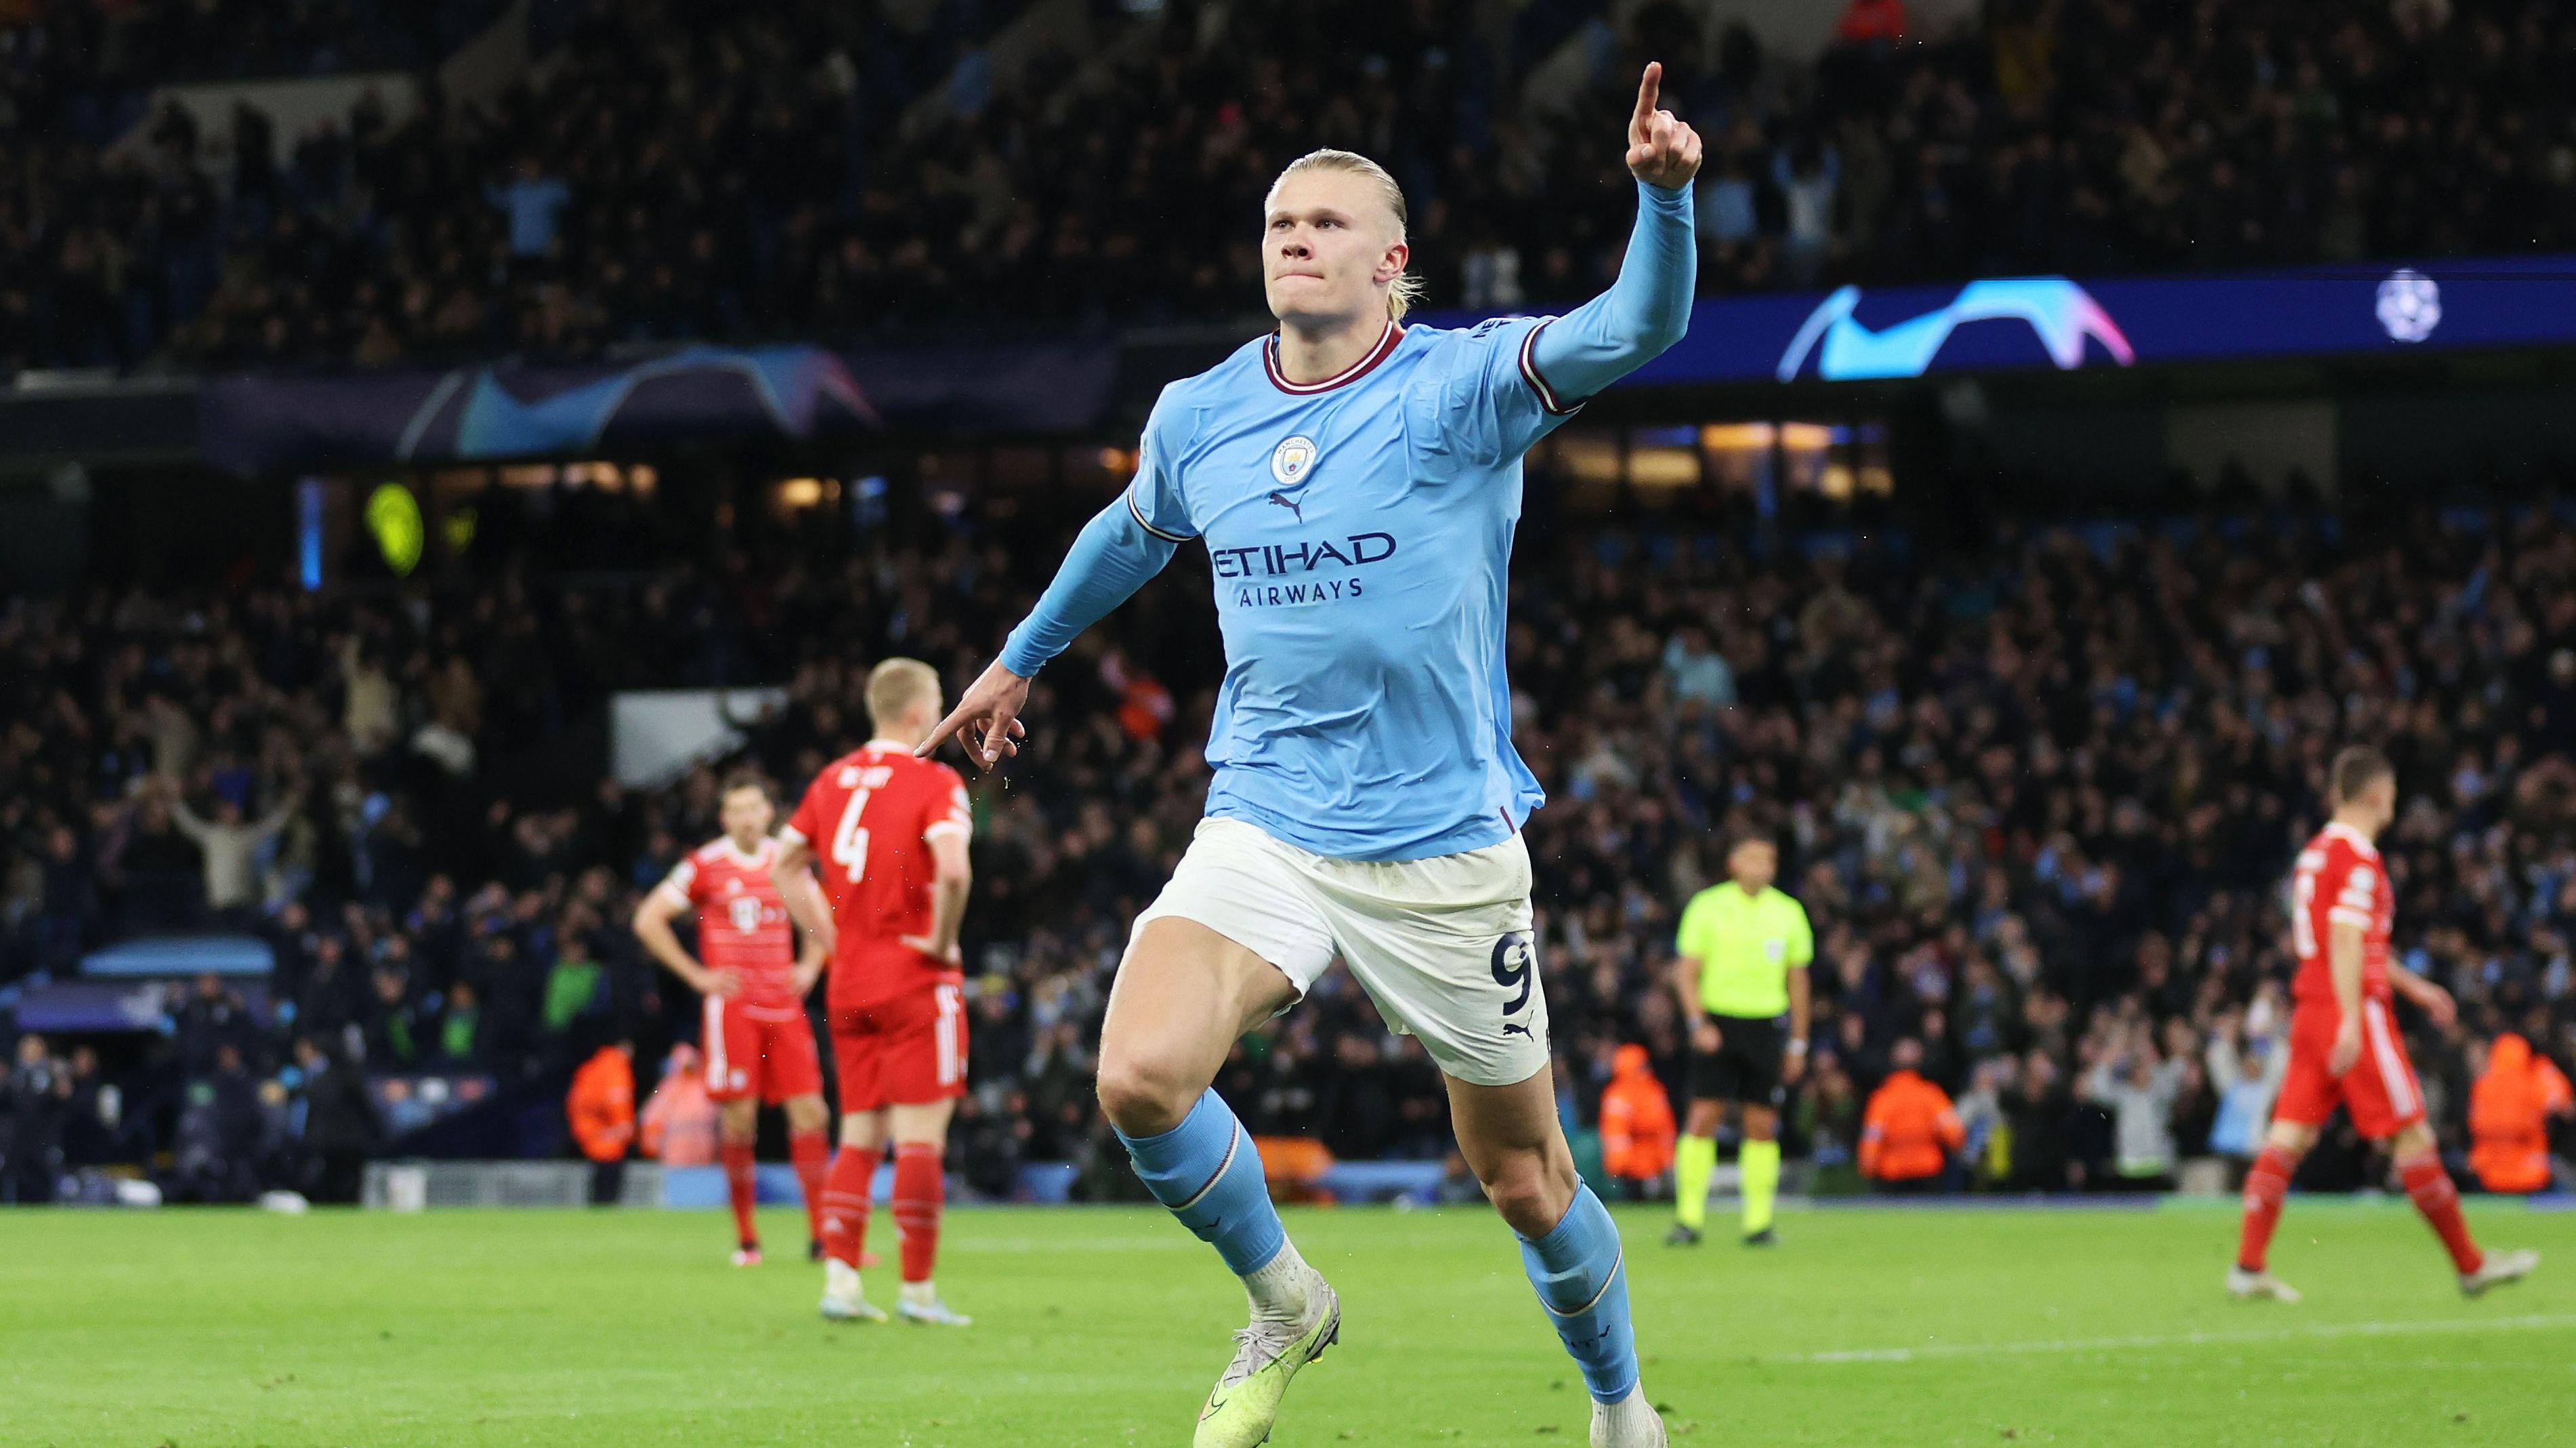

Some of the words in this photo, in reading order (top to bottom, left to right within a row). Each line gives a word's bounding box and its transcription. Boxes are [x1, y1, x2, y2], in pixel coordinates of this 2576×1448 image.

[1213, 532, 1397, 577] ETIHAD
[1240, 577, 1363, 607] AIRWAYS
[833, 787, 870, 883] 4
[1491, 932, 1532, 1016] 9
